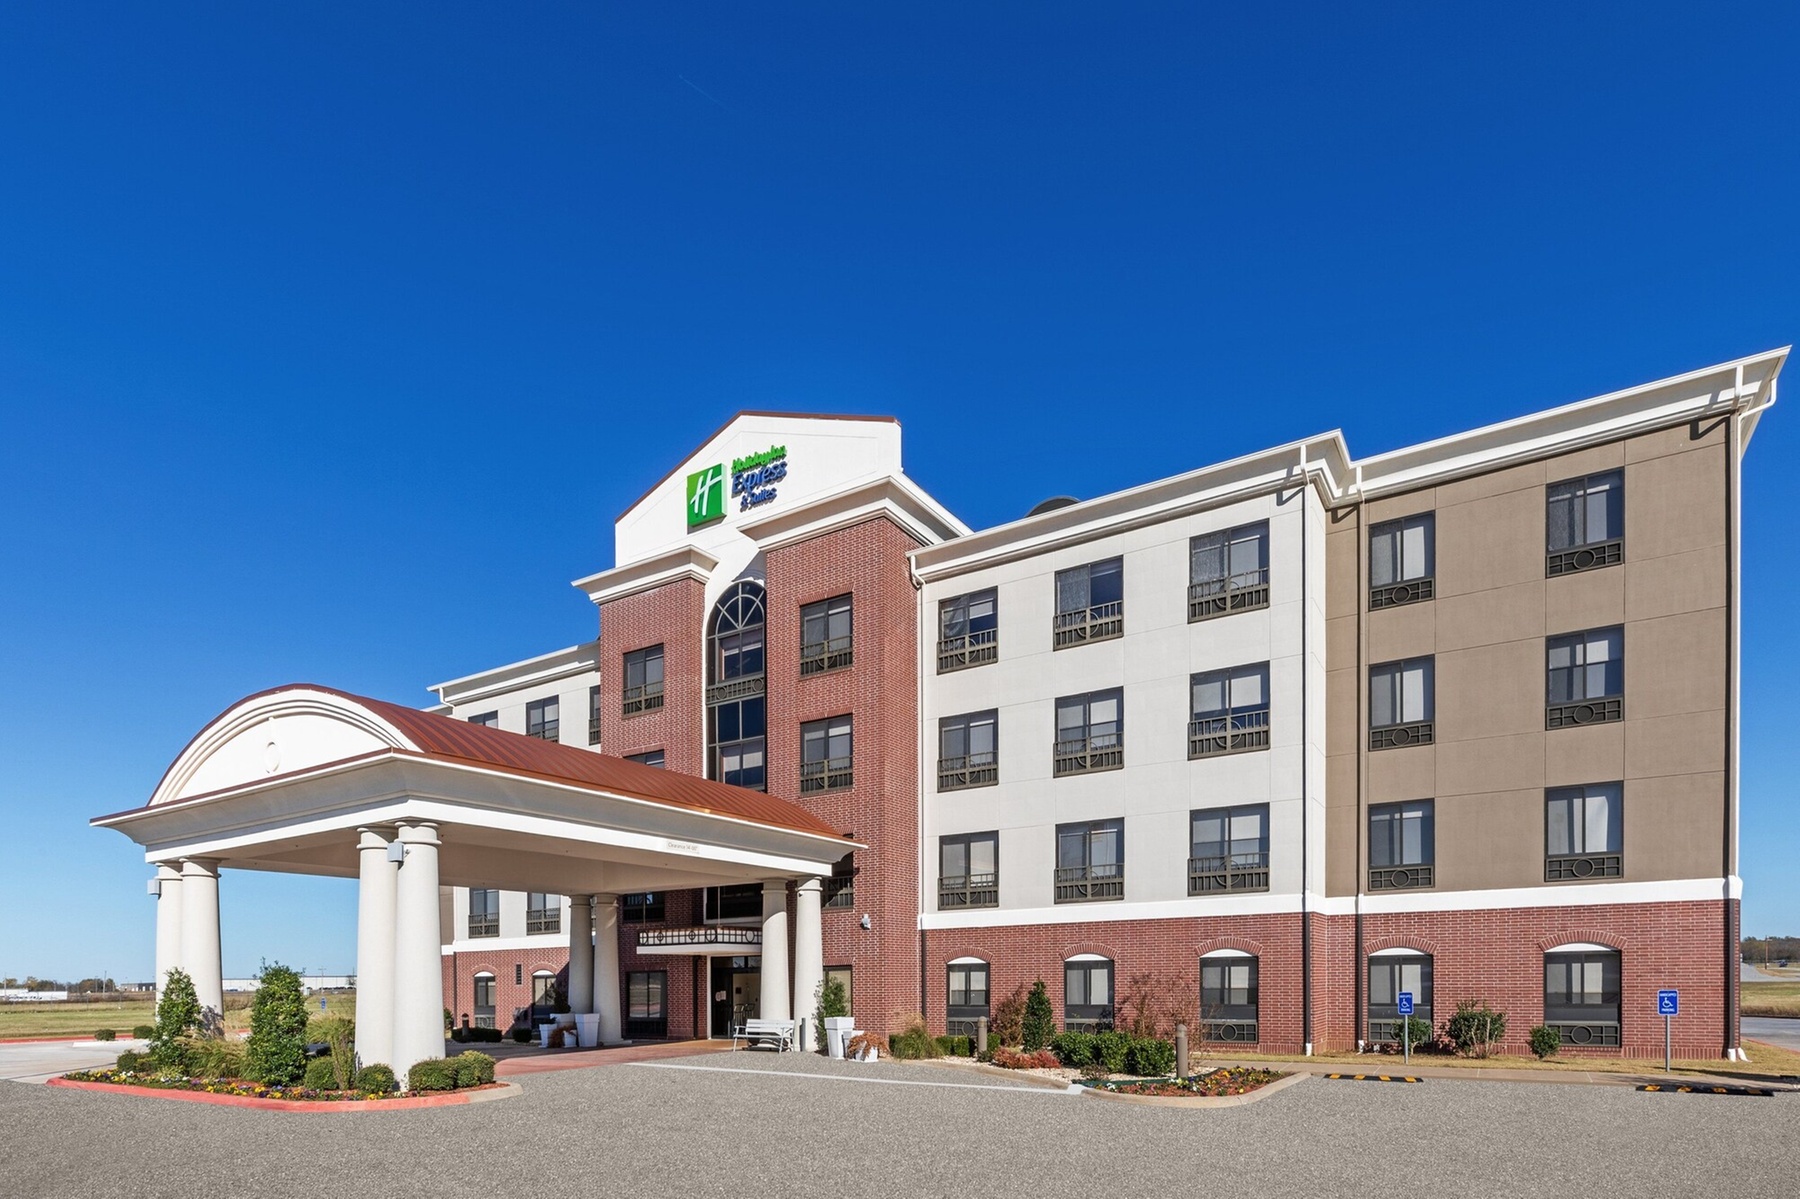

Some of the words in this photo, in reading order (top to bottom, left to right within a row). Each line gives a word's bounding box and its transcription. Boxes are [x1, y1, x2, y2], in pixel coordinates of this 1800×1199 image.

[731, 452, 770, 474] Holiday
[770, 445, 787, 460] Inn
[732, 461, 787, 497] Express
[749, 487, 777, 508] Suites
